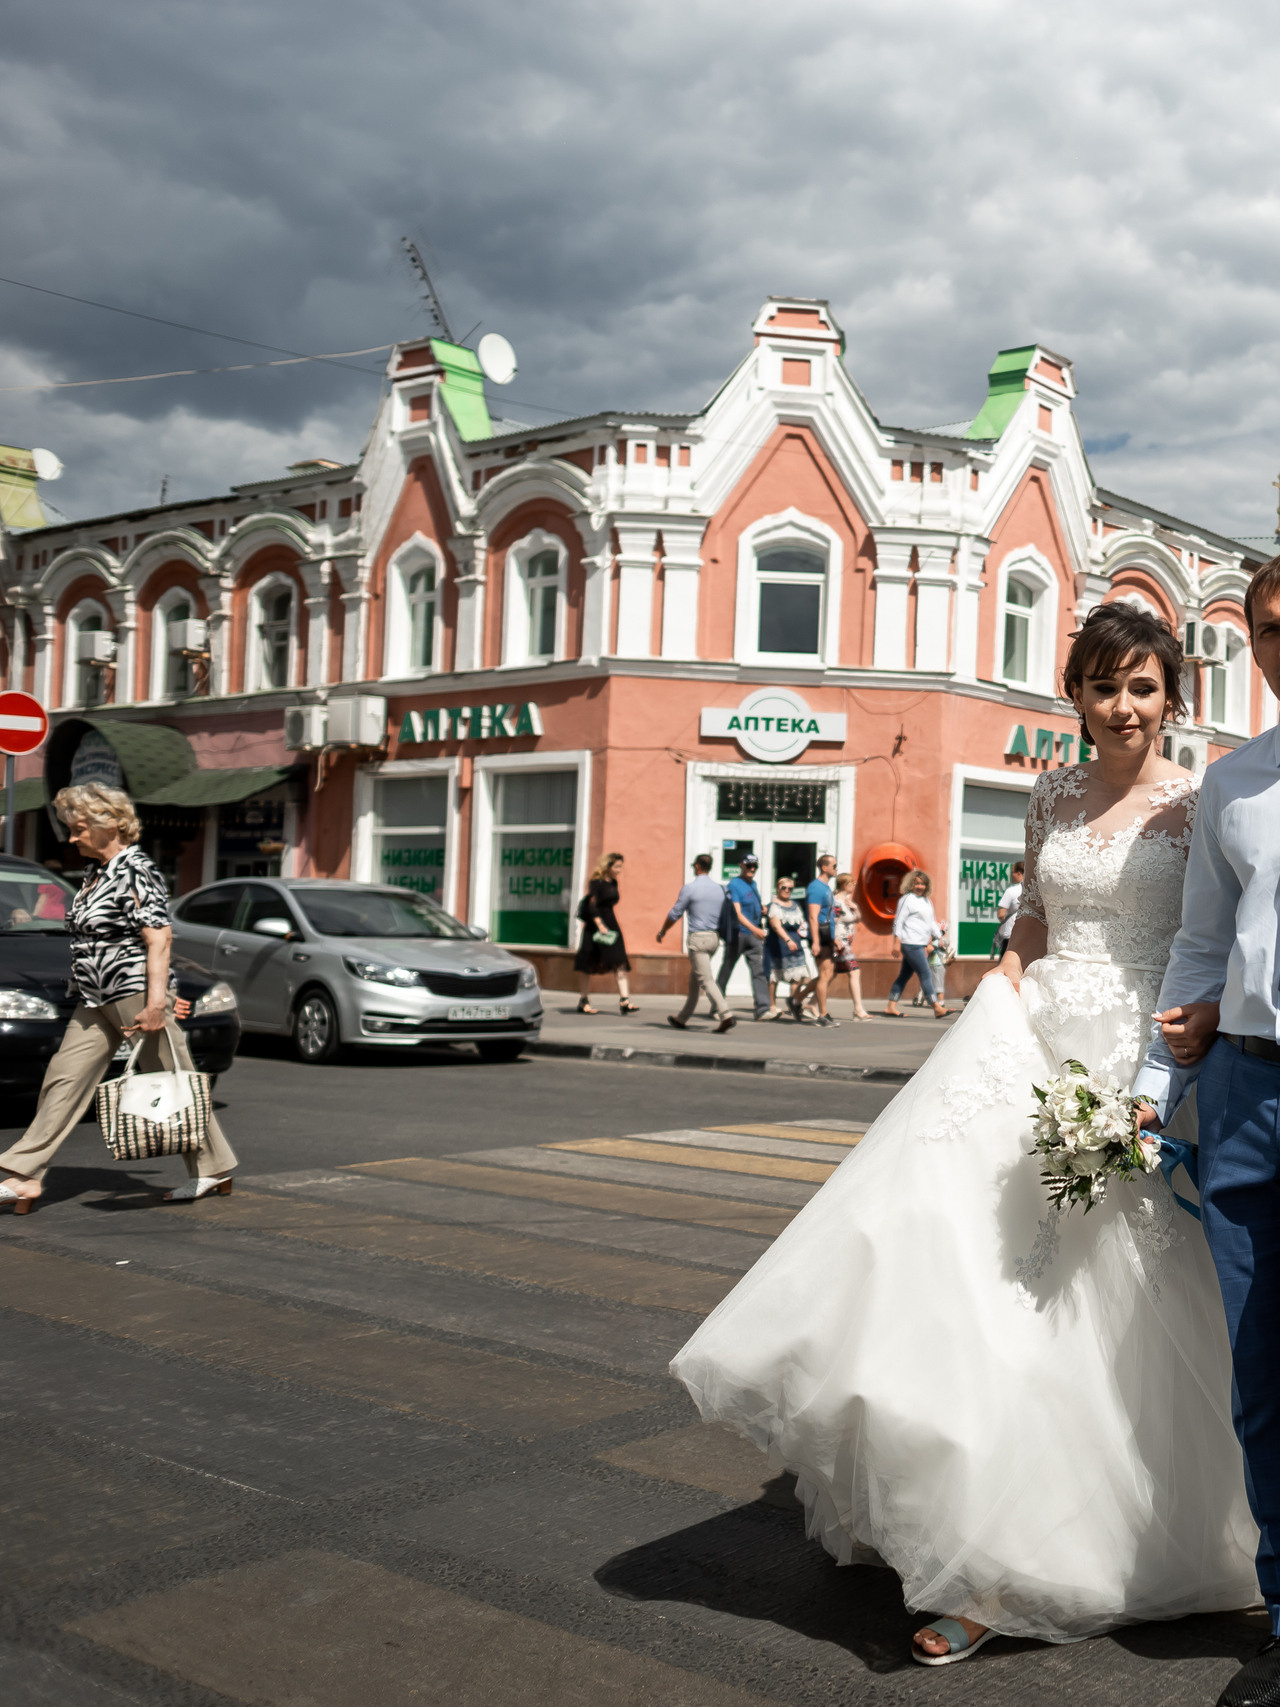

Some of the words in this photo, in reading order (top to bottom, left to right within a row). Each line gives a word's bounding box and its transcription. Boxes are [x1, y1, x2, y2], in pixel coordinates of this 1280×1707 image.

[399, 702, 544, 743] АПТЕКА
[727, 716, 820, 734] АПТЕКА
[1004, 725, 1098, 764] АПТЕ
[381, 848, 445, 867] НИЗКИЕ
[501, 848, 572, 867] НИЗКИЕ
[963, 860, 1012, 881] НИЗК
[509, 876, 563, 897] ЦЕНЫ
[971, 889, 1004, 911] ЦЕН
